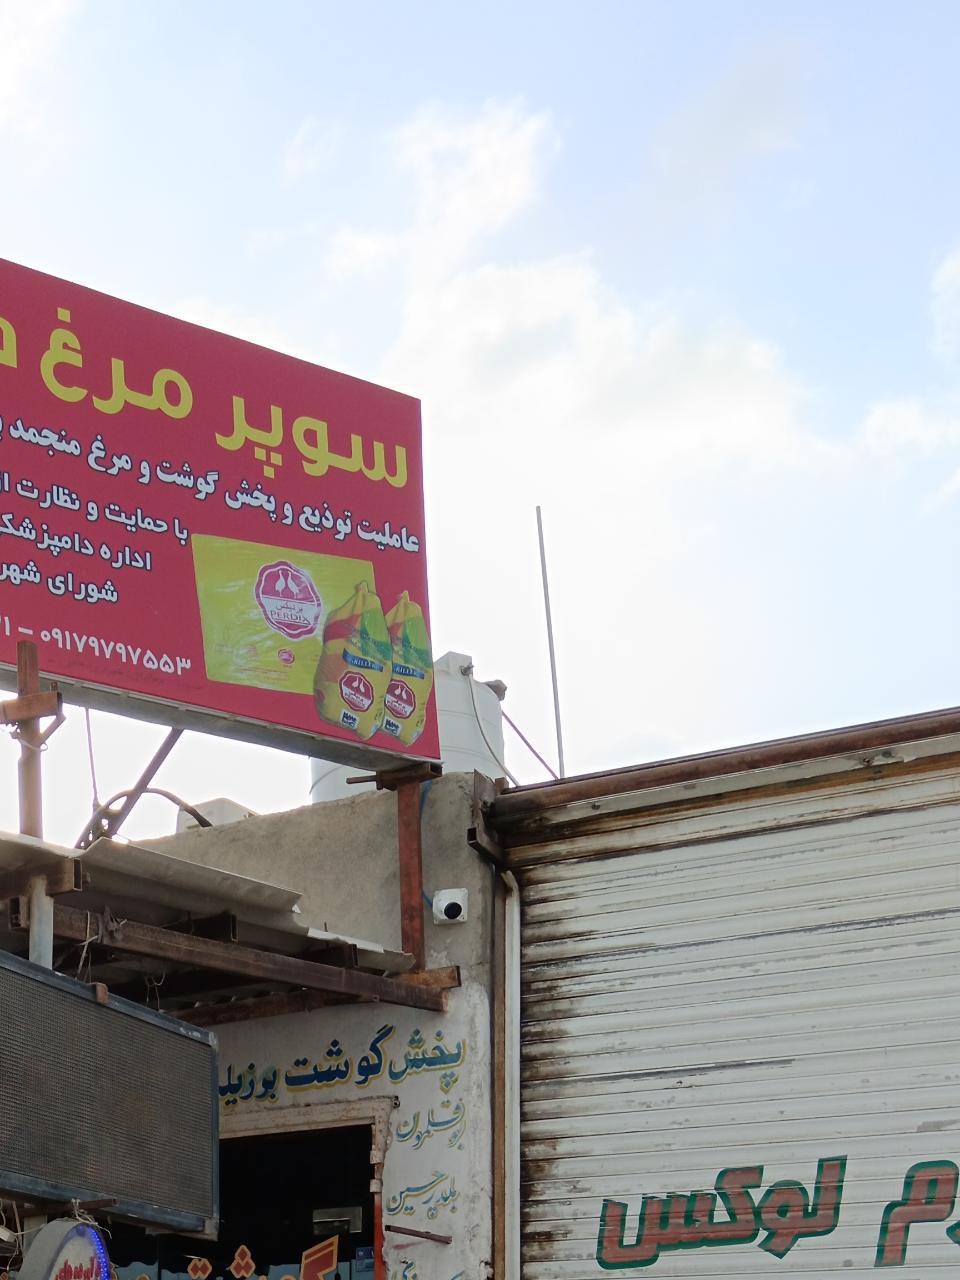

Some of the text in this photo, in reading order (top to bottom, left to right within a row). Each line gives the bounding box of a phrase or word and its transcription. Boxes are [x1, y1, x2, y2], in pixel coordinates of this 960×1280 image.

[39, 307, 194, 420] مرغ
[8, 419, 82, 457] منجمد
[87, 434, 134, 475] مرغ
[215, 394, 408, 489] سوپر
[138, 460, 151, 485] و
[155, 458, 220, 500] گوشت
[16, 478, 81, 512] نظارت
[86, 500, 98, 522] و
[223, 481, 277, 522] پخش
[281, 502, 294, 525] و
[104, 501, 169, 534] حمایت
[173, 518, 190, 547] با
[356, 519, 421, 553] عاملیت
[100, 543, 153, 572] اداره
[46, 572, 120, 603] شورای
[40, 628, 192, 676] ۰۹۱۷۹۷۹۷۵۵۳
[284, 1024, 395, 1092] گوشت
[389, 1027, 468, 1095] پخش
[596, 1155, 848, 1271] لوکس
